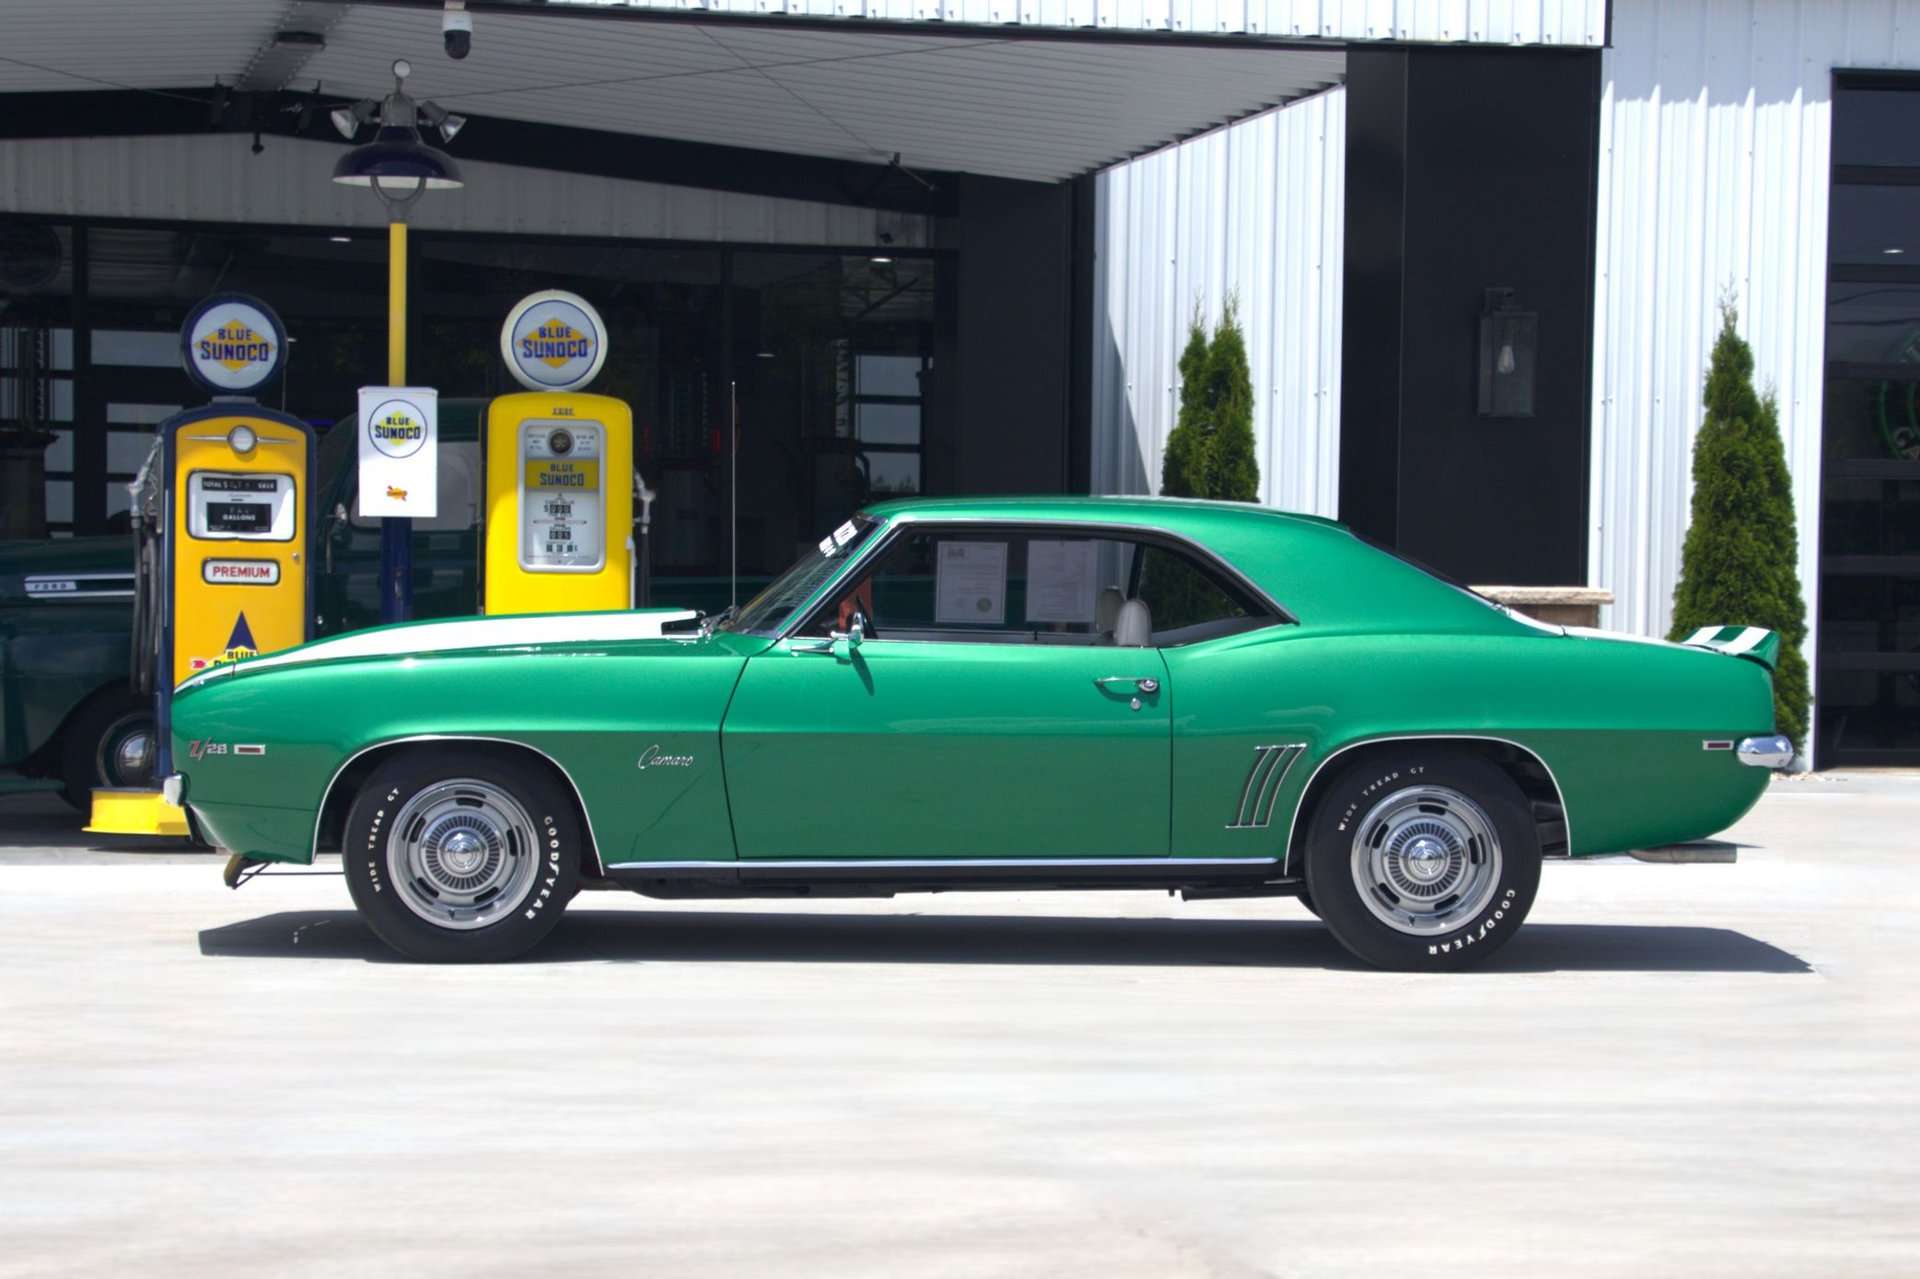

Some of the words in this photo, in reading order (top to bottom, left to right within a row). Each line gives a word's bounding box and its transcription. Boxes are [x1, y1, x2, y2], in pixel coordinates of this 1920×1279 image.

[217, 328, 253, 341] BLUE
[537, 326, 572, 338] BLUE
[200, 341, 269, 361] SUNOCO
[522, 338, 588, 358] SUNOCO
[386, 416, 410, 425] BLUE
[374, 425, 421, 440] SUNOCO
[550, 463, 574, 472] BLUE
[540, 472, 584, 486] SUNOCO
[221, 513, 256, 522] GALLONS
[212, 565, 271, 579] PREMIUM
[638, 744, 694, 770] Camaro
[386, 787, 400, 802] GT
[1337, 803, 1358, 832] WIDE
[1361, 771, 1399, 797] TREAD
[1409, 765, 1425, 776] GT
[367, 809, 385, 850] TREAD
[524, 815, 560, 920] GOODYEAR
[367, 861, 382, 893] WIDE
[1427, 888, 1516, 955] GOODYEAR
